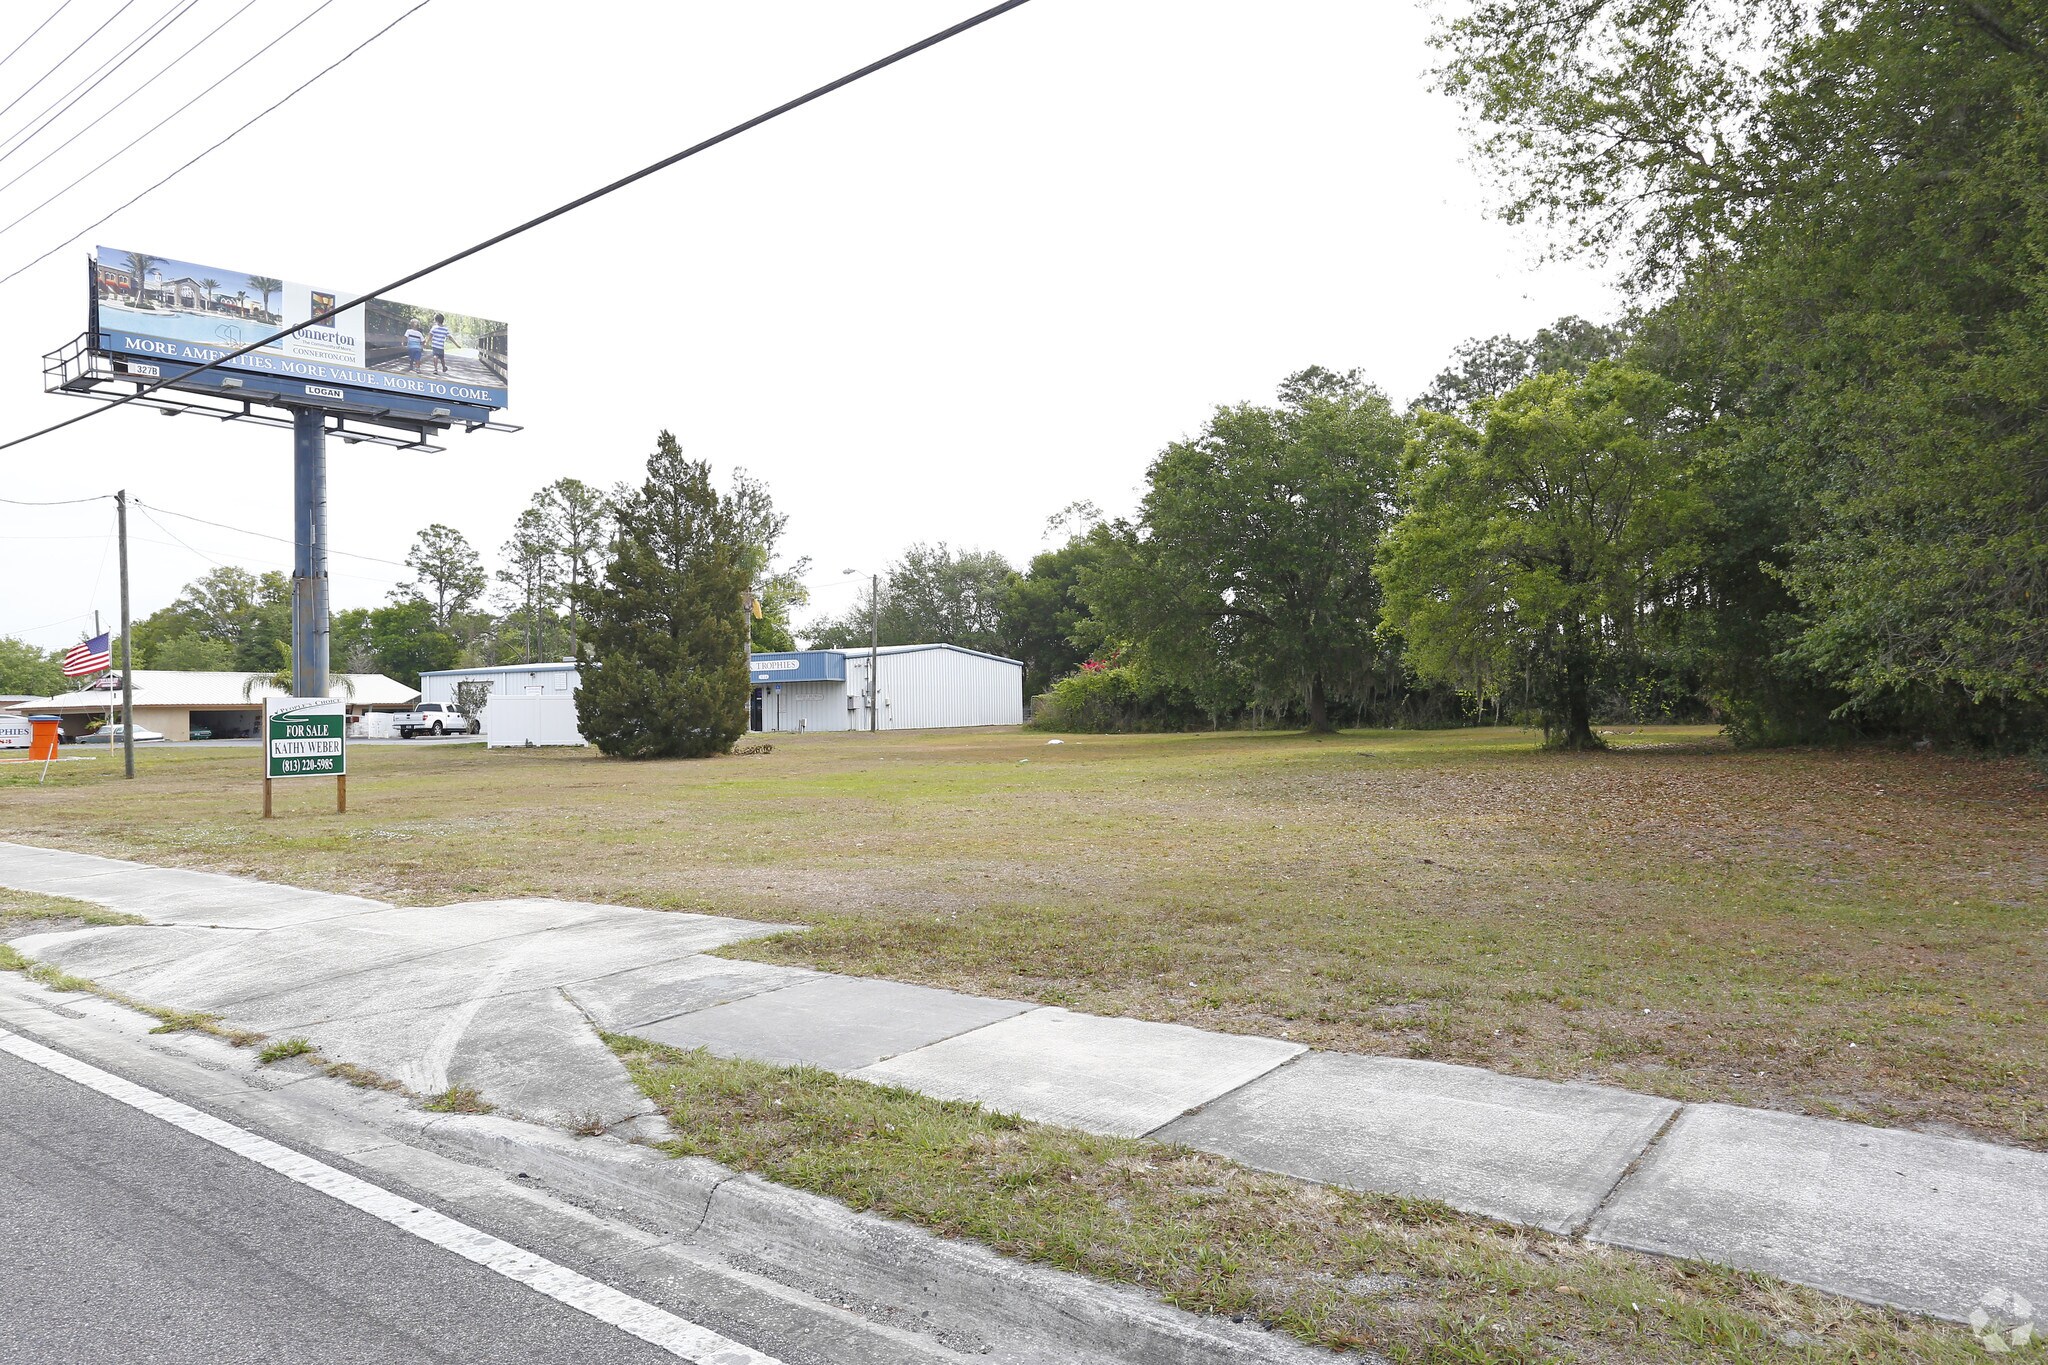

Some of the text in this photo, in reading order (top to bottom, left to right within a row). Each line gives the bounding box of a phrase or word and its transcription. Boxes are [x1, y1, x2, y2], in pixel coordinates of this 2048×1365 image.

[293, 347, 356, 363] CONNERTON.COM
[125, 337, 178, 355] MORE
[281, 361, 327, 378] MORE
[330, 368, 379, 385] VALUE.
[383, 376, 425, 392] MORE
[427, 383, 446, 395] TO
[450, 387, 492, 401] COME.
[137, 365, 158, 375] 327B
[309, 387, 340, 397] LOGAN
[756, 661, 796, 670] TROPHIES
[286, 724, 329, 737] FOR SALE
[275, 740, 340, 754] KATHY WEBER
[282, 758, 333, 773] (813) 220-5985
